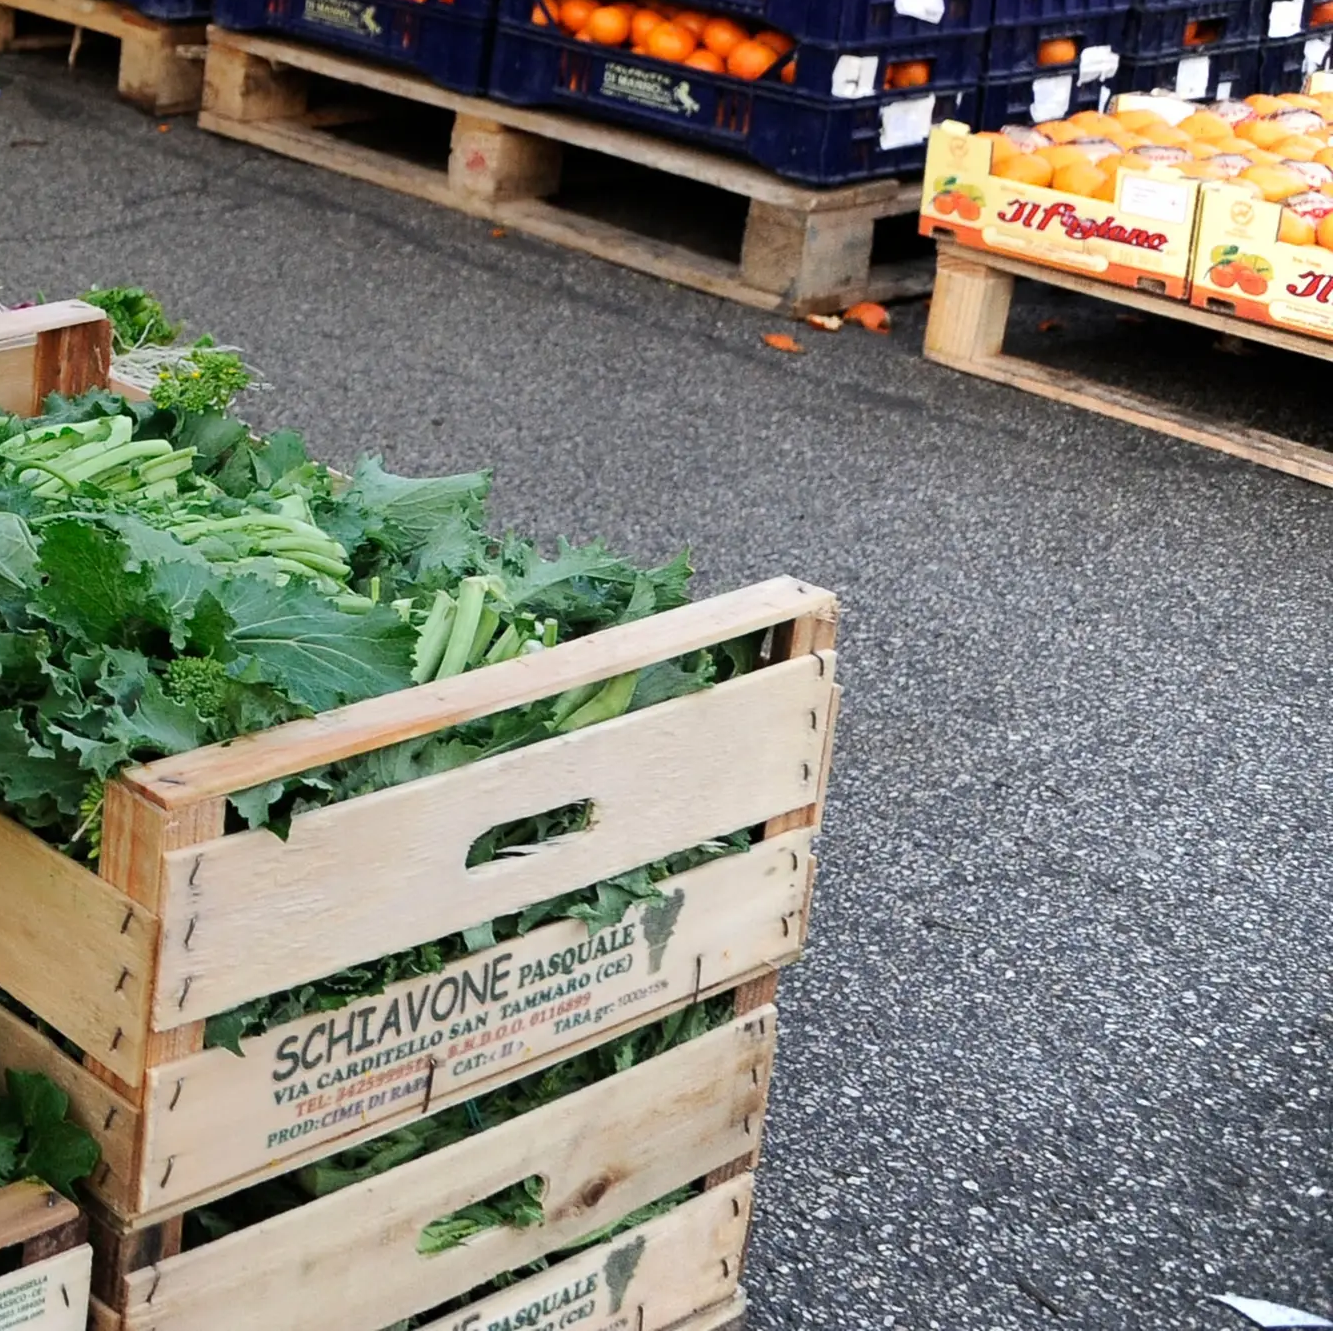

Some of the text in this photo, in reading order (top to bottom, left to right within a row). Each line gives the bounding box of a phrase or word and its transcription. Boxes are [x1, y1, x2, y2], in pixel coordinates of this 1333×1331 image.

[273, 923, 636, 1081] SCHIAVONE PASQUALE
[273, 953, 634, 1106] VIA CARDITELLO SAN TAMMARO (CE)
[553, 1011, 592, 1036] TARA
